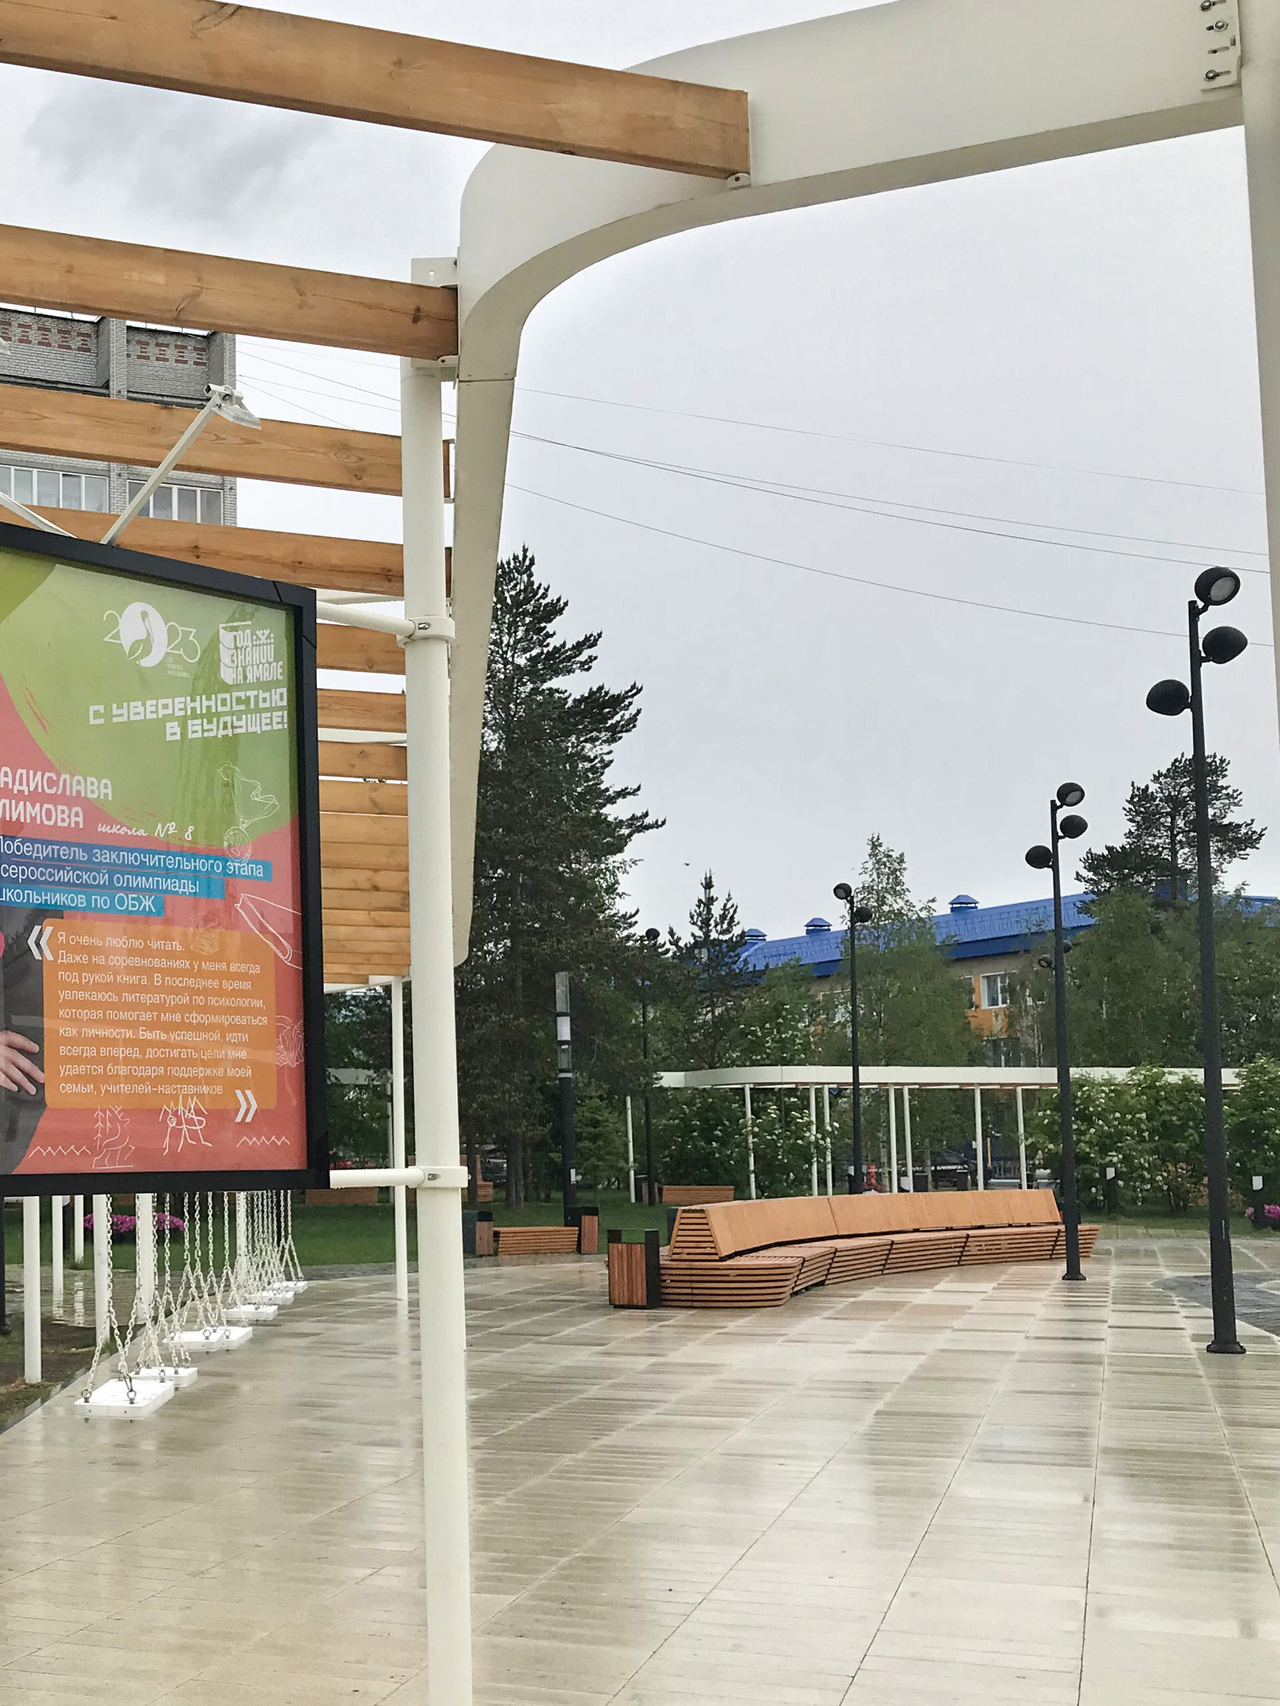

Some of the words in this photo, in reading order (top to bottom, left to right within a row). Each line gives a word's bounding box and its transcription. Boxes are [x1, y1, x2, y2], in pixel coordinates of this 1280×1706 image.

[246, 661, 283, 684] ЯМАЛЕ
[89, 704, 105, 725] С
[112, 687, 288, 723] УВЕРЕННОСТЬЮ
[165, 721, 181, 741] В
[187, 710, 288, 739] БУДУЩЕЕ!
[97, 822, 148, 837] школа
[184, 825, 195, 841] 8
[92, 848, 222, 875] заключительного
[226, 861, 264, 878] этапа
[113, 873, 200, 895] олимпиады
[91, 897, 110, 910] по
[114, 893, 156, 912] ОБЖ
[57, 931, 66, 944] Я
[69, 934, 102, 946] очень
[105, 936, 144, 949] люблю
[147, 940, 185, 951] читать.
[57, 950, 89, 965] Даже
[92, 955, 105, 965] на
[108, 955, 191, 969] соревнованиях
[193, 961, 199, 972] у
[201, 961, 227, 971] меня
[229, 963, 261, 975] всегда
[58, 971, 79, 984] под
[82, 971, 114, 985] рукой
[116, 974, 151, 985] книга.
[153, 973, 162, 986] В
[164, 976, 220, 990] последнее
[222, 979, 252, 992] время
[58, 990, 119, 1003] увлекаюсь
[121, 992, 190, 1007] литературой
[192, 995, 205, 1006] по
[207, 996, 266, 1010] психологии,
[58, 1008, 103, 1021] которая
[106, 1010, 158, 1021] помогает
[160, 1012, 182, 1022] мне
[184, 1011, 268, 1027] сформироваться
[59, 1027, 78, 1037] как
[81, 1027, 136, 1039] личности.
[139, 1027, 167, 1040] Быть
[226, 1032, 249, 1043] идти
[59, 1045, 97, 1058] всегда
[99, 1047, 143, 1060] вперед,
[145, 1047, 198, 1059] достигать
[200, 1050, 226, 1060] цели
[227, 1050, 247, 1059] мне
[59, 1064, 104, 1077] удается
[106, 1063, 165, 1078] благодаря
[167, 1066, 224, 1079] поддержке
[227, 1065, 252, 1077] моей
[59, 1083, 97, 1095] семьи,
